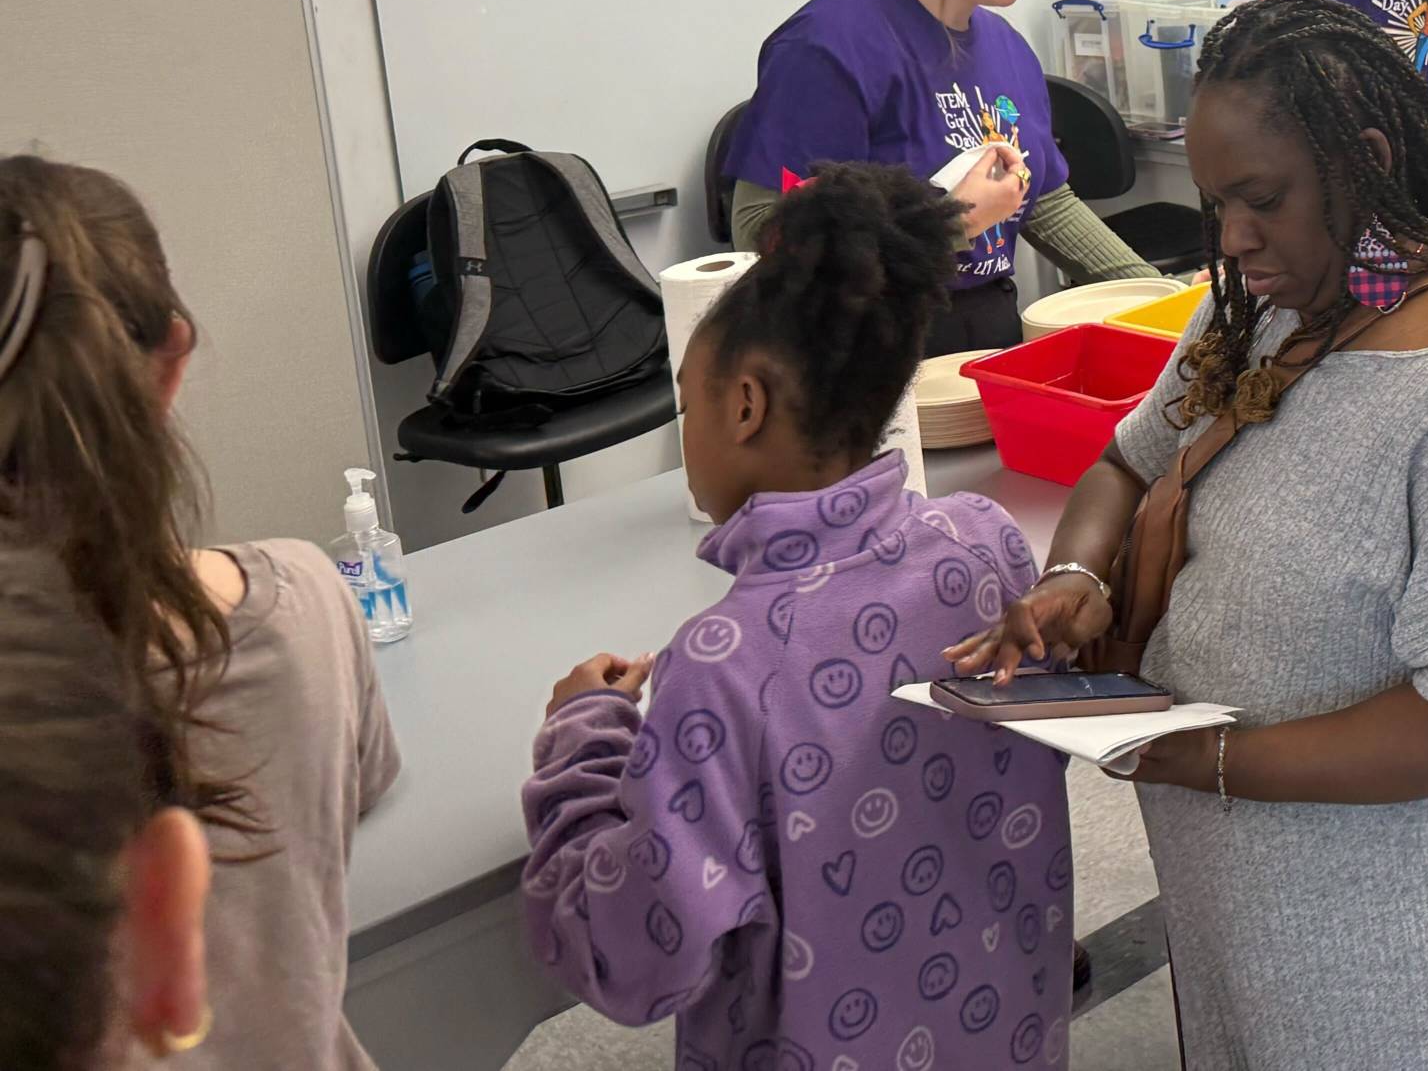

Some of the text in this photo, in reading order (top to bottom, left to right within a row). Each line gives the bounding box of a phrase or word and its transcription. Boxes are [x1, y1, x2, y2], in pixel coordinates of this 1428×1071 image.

[936, 93, 970, 110] STEM
[945, 111, 970, 129] Girl
[950, 133, 978, 150] Day
